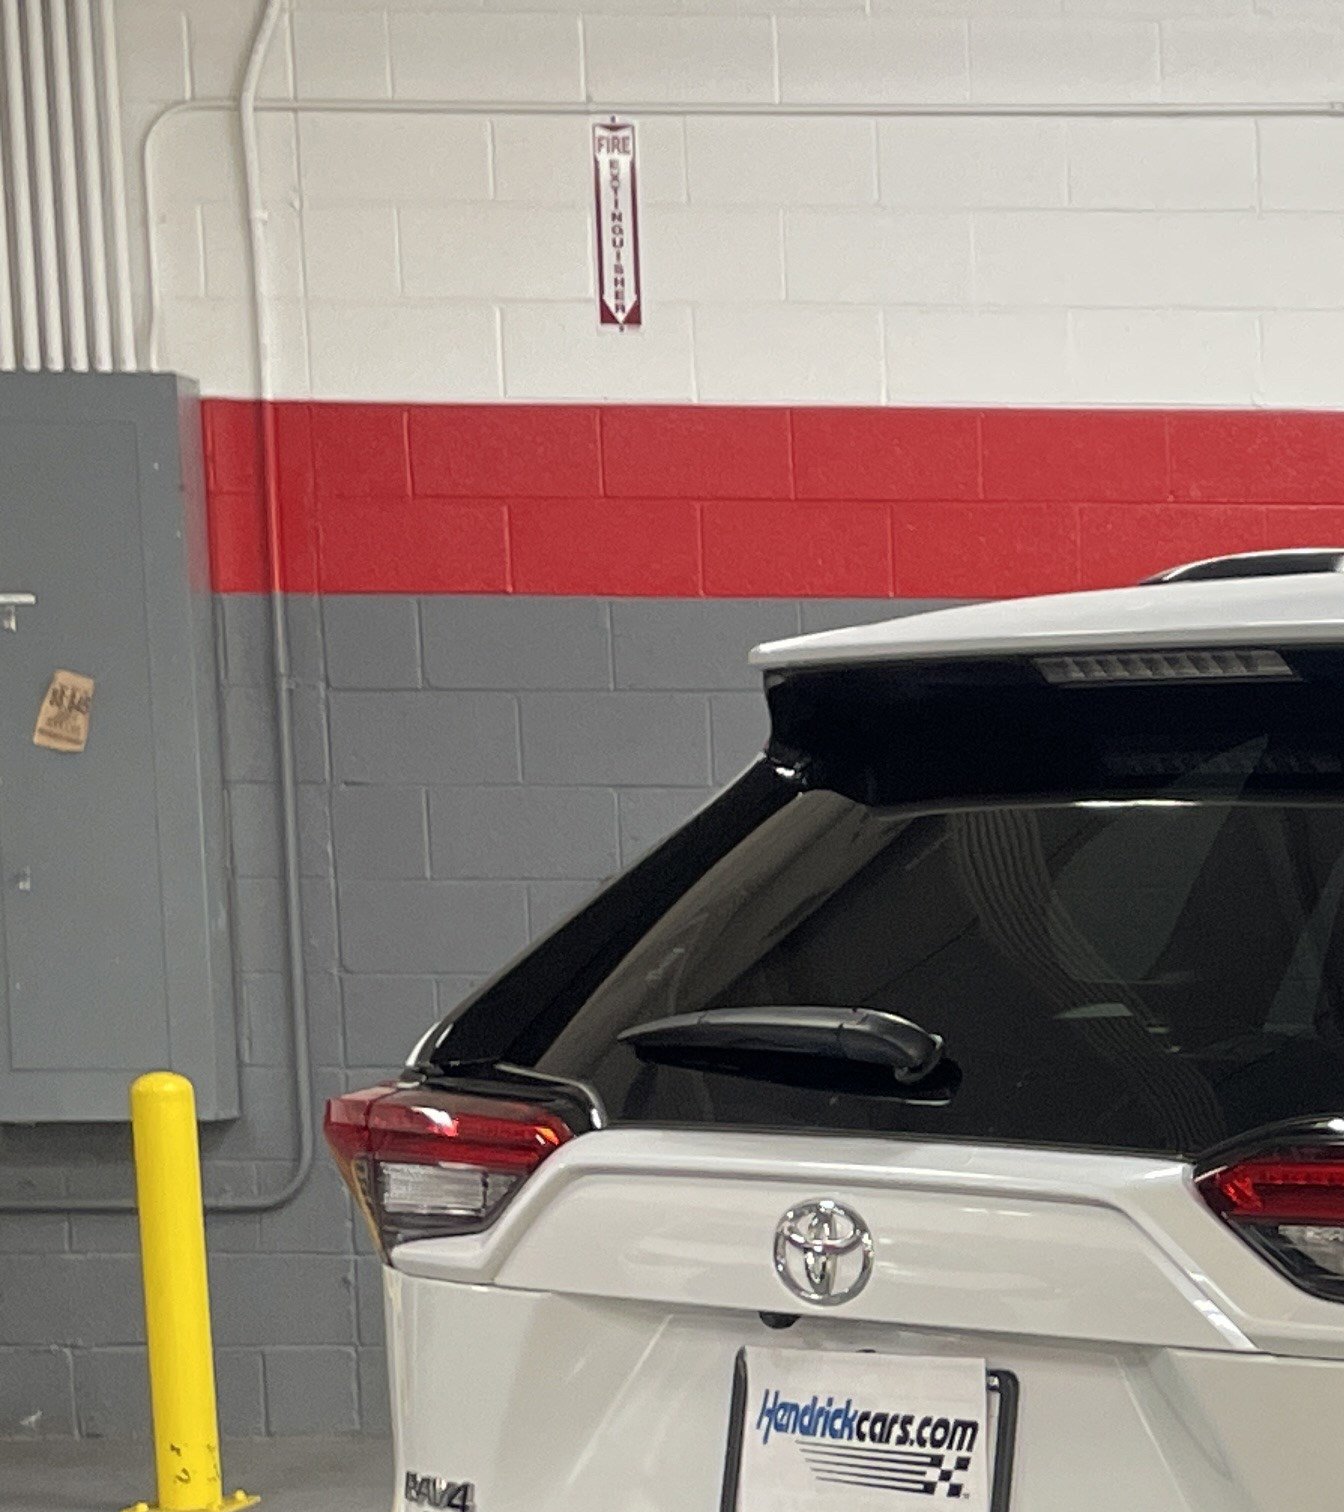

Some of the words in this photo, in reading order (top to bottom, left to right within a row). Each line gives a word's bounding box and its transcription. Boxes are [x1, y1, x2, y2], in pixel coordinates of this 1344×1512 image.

[597, 136, 631, 154] FIRE
[609, 158, 626, 315] EXTINGUISHER
[756, 1388, 980, 1452] Hendrickcars.com
